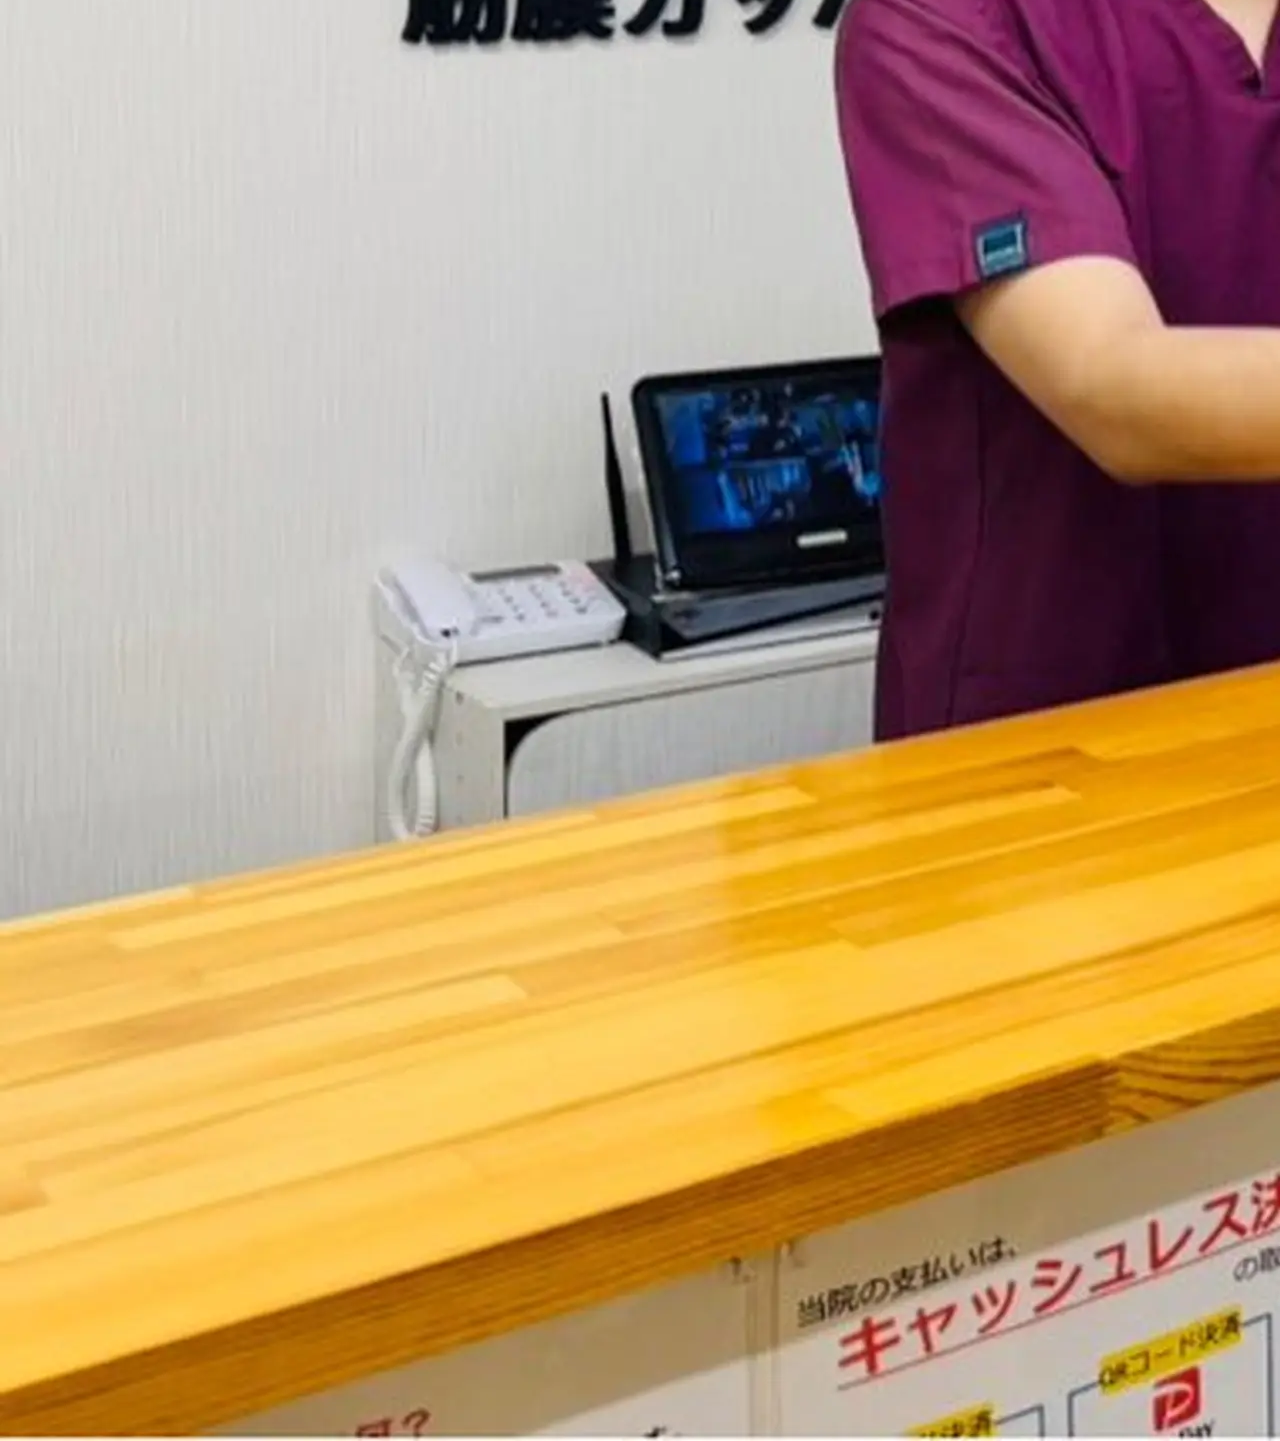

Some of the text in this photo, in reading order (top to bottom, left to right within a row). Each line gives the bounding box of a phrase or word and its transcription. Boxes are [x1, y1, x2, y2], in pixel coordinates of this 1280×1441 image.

[798, 1236, 1016, 1327] 当院の支払いは、
